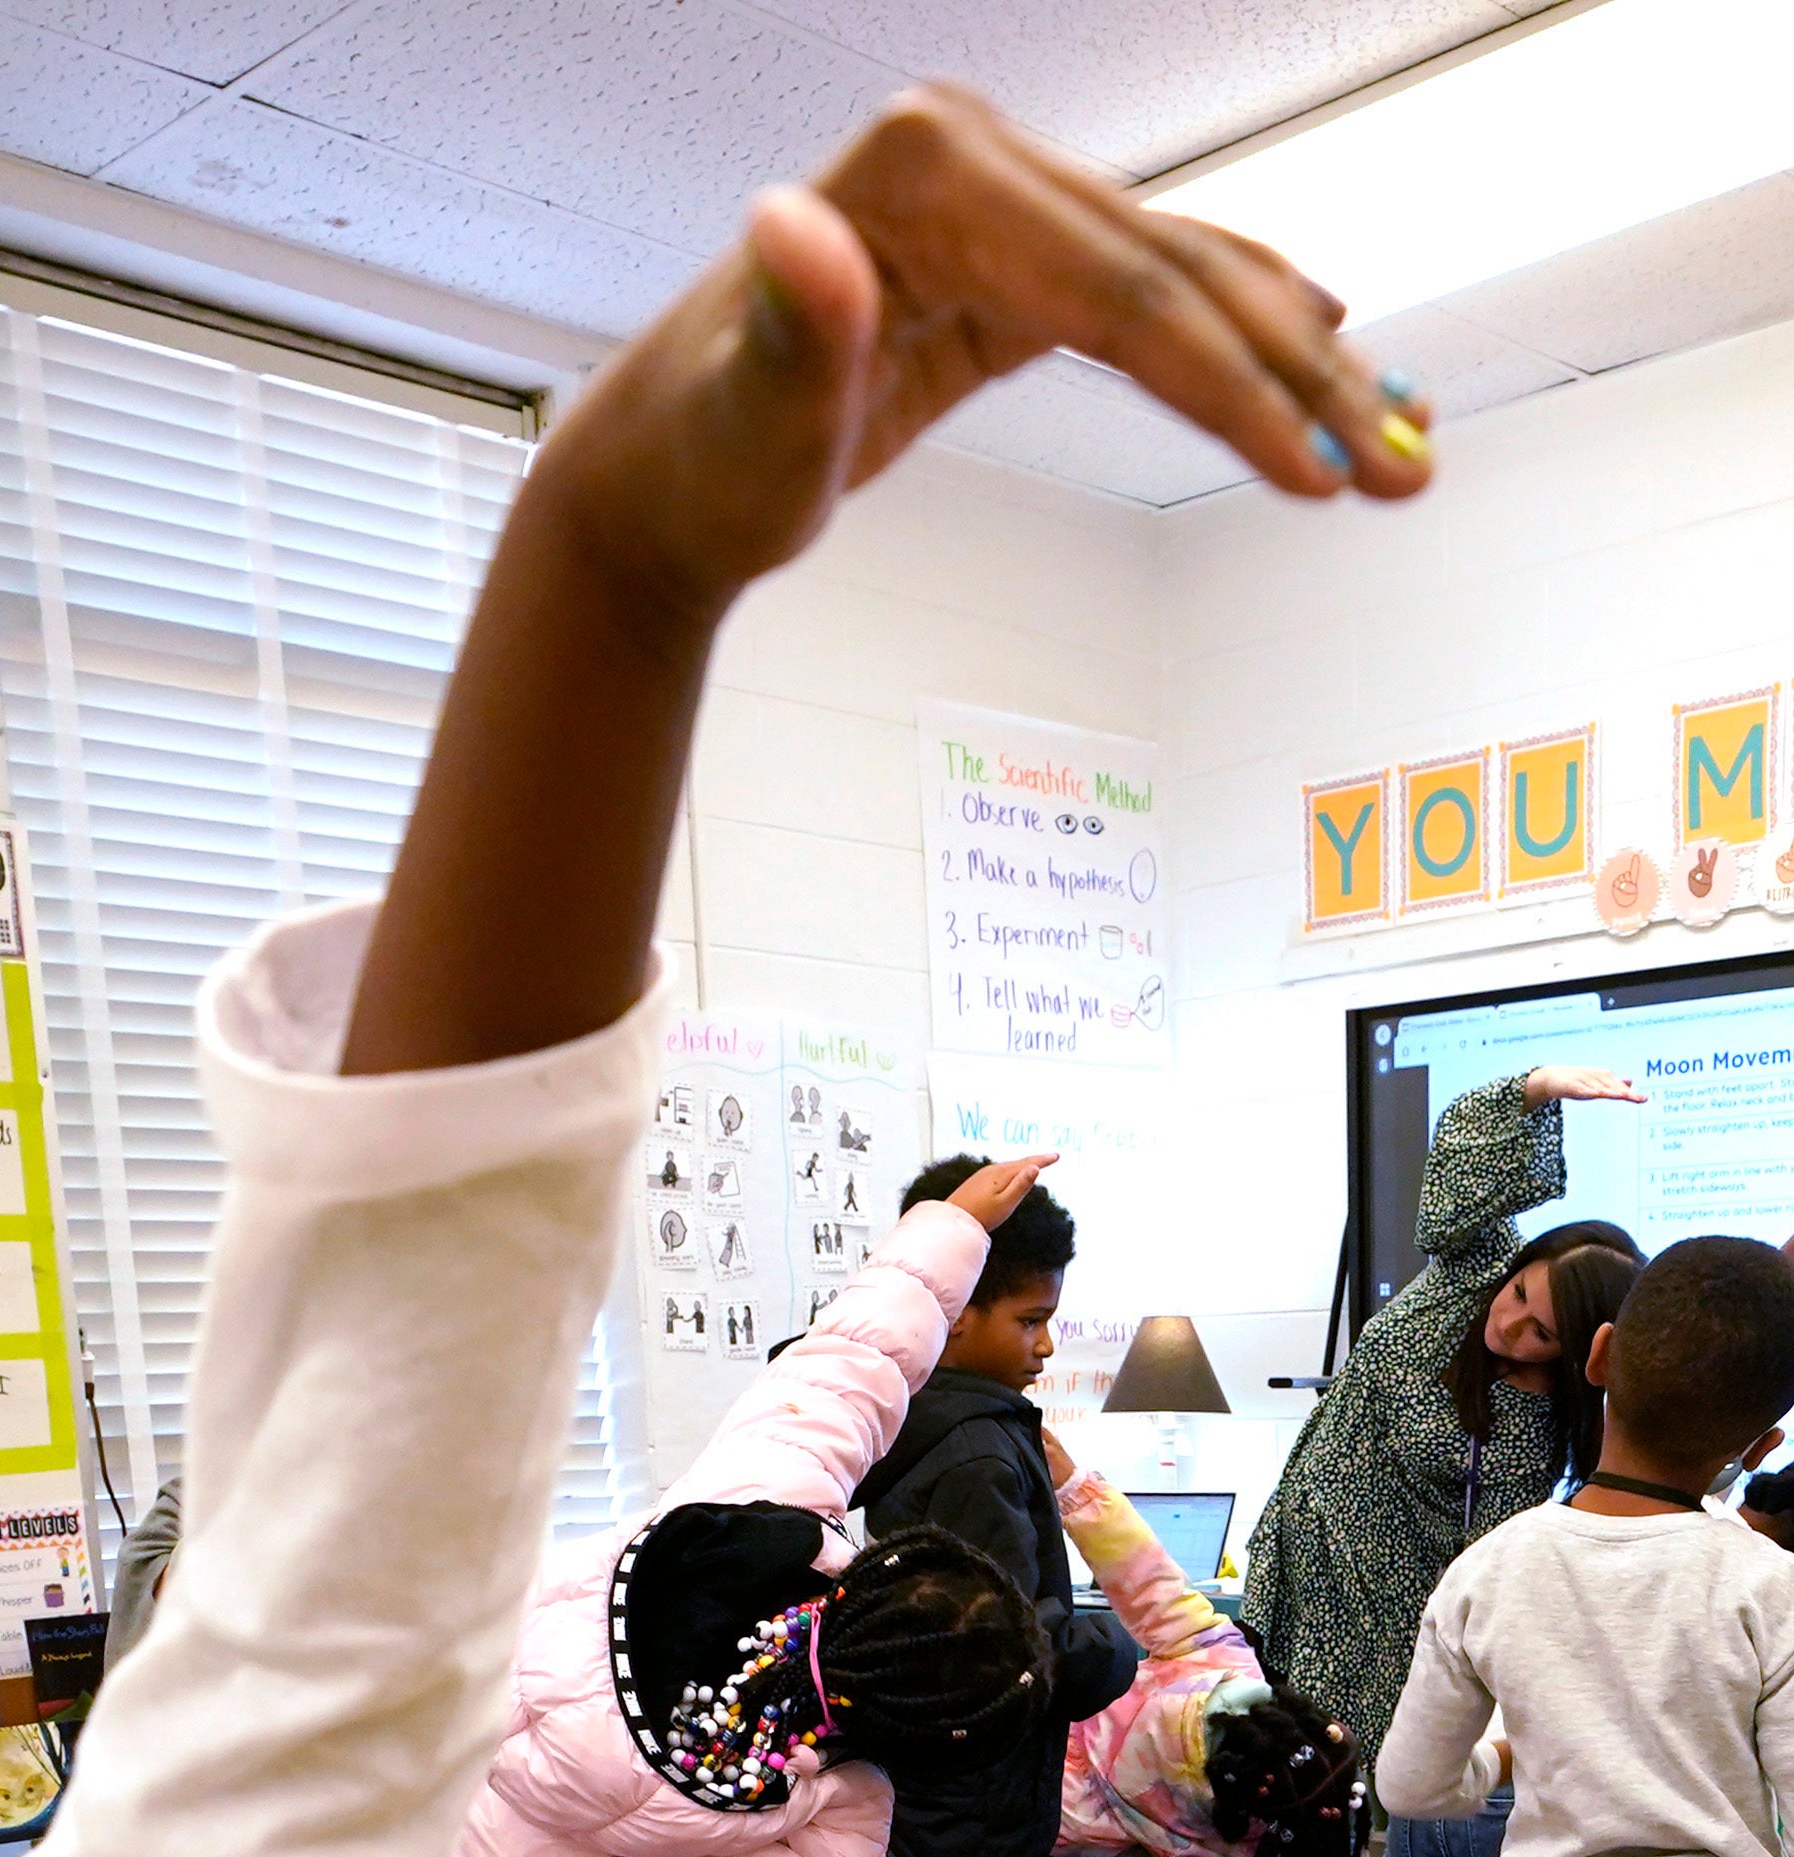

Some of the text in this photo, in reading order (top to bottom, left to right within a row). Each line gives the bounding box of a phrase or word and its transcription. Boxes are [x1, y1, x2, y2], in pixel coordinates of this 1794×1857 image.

[942, 741, 1152, 812] The Scientific Method
[962, 792, 1044, 832] Observe
[1315, 760, 1579, 896] YOU
[967, 849, 1125, 899] Make a hypothesis
[977, 913, 1089, 959] Experiment
[984, 975, 1103, 1019] Tell what we
[1007, 1015, 1077, 1052] learned
[1646, 1058, 1704, 1078] Moon
[1664, 1088, 1694, 1100] Stand
[1697, 1085, 1718, 1097] with
[1722, 1082, 1742, 1094] feet
[9, 1515, 78, 1537] LEVELS
